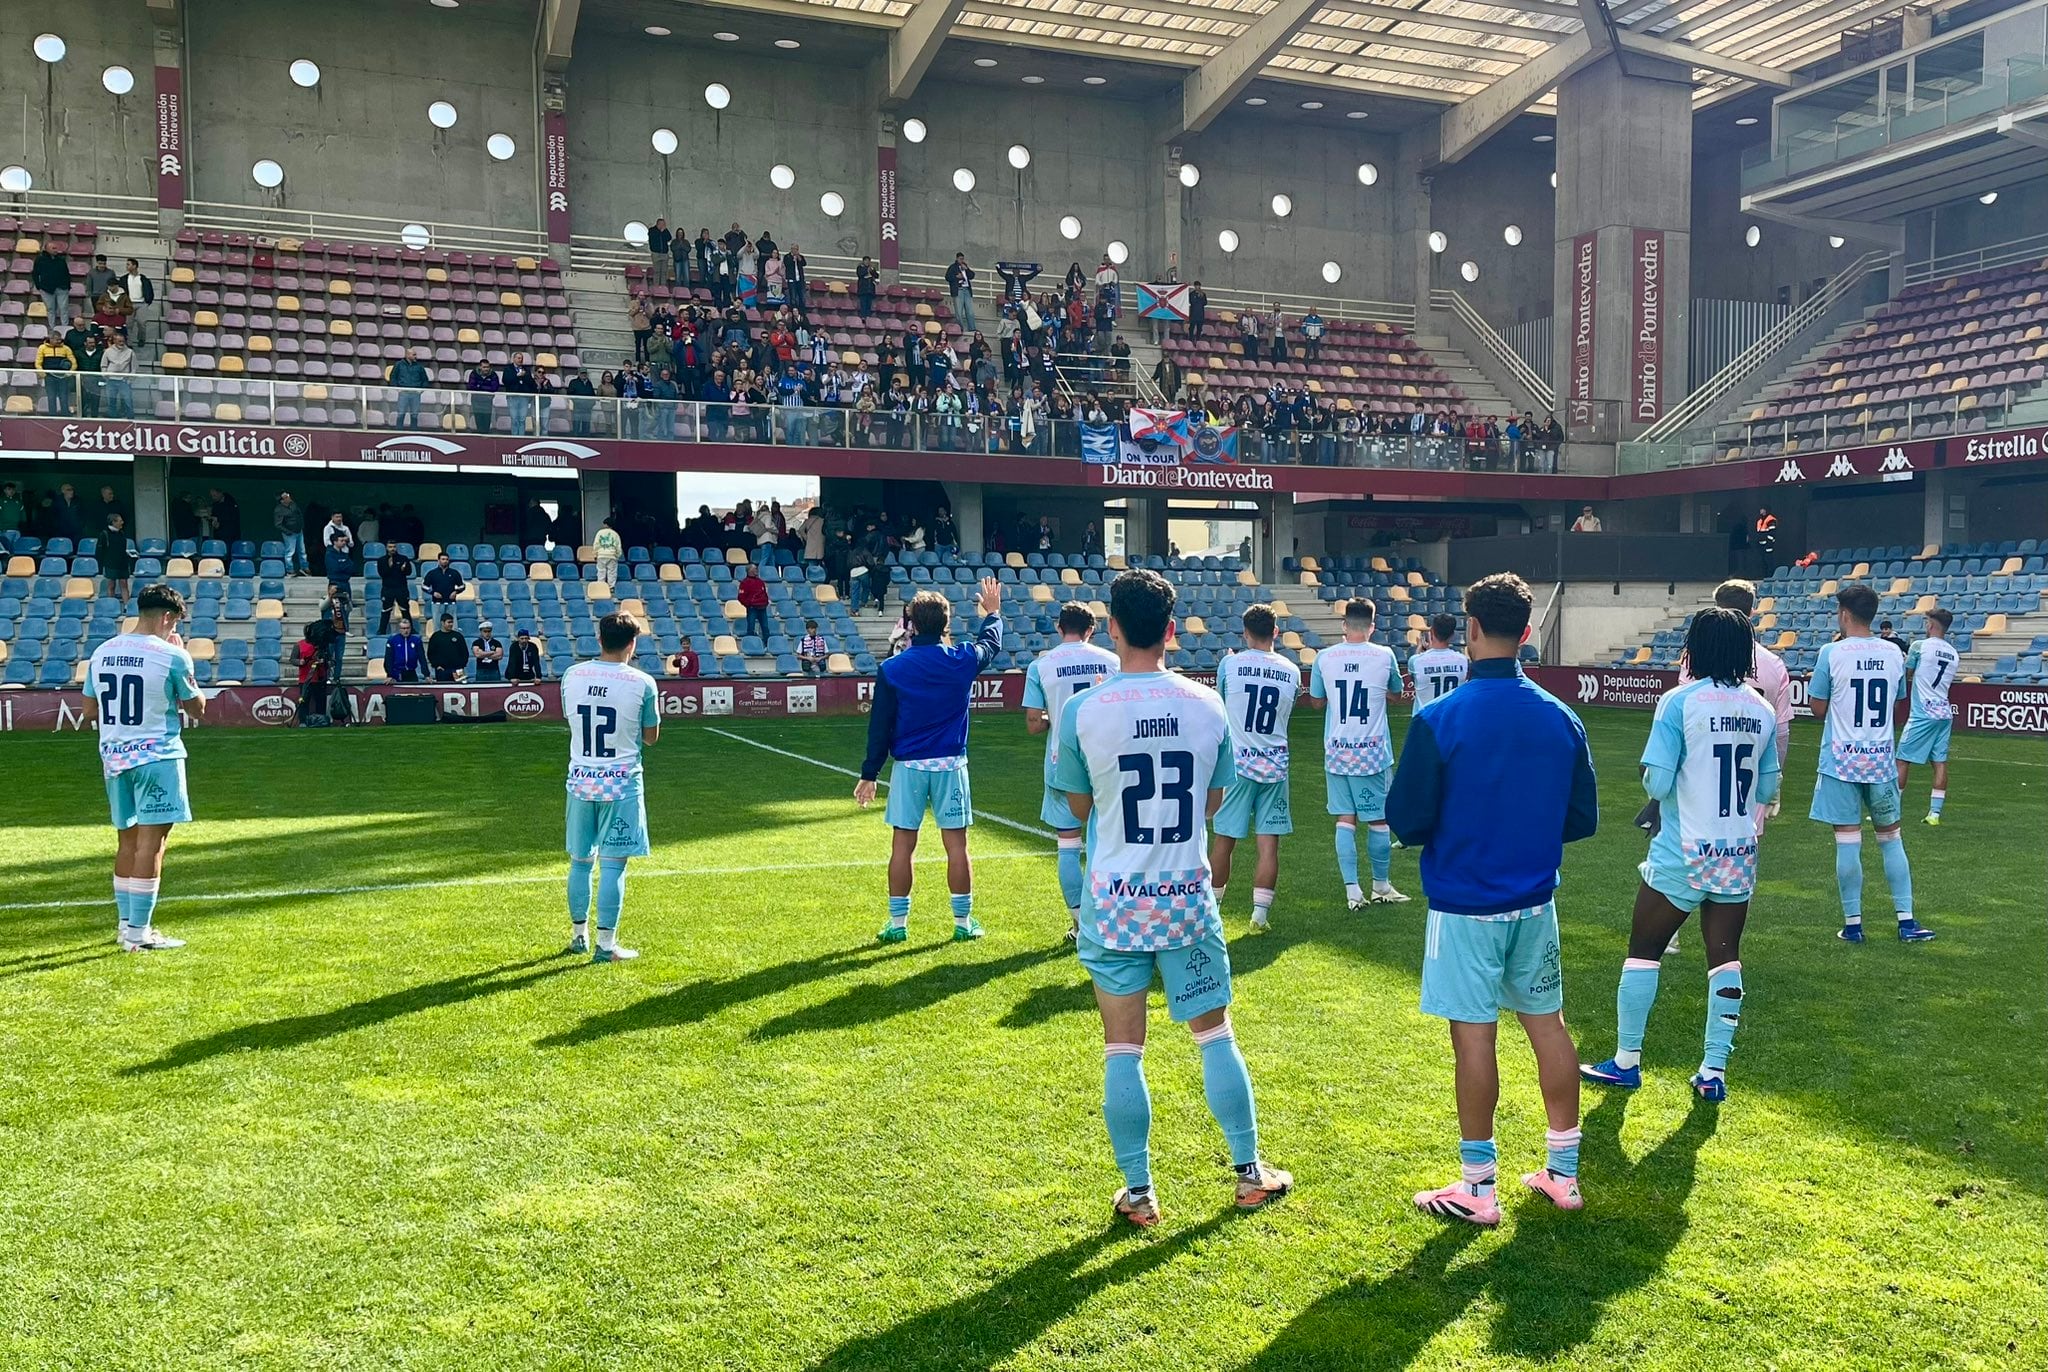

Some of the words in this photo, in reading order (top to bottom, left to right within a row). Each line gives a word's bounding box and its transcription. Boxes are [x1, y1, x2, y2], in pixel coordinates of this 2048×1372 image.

[158, 93, 170, 150] Deputación
[169, 94, 178, 151] Pontevedra
[547, 135, 558, 187] Deputación
[557, 136, 565, 188] Pontevedra
[881, 169, 889, 218] Deputación
[60, 423, 171, 451] Estrella
[176, 427, 275, 455] Galicia
[1965, 434, 2038, 462] Estrella
[1126, 452, 1141, 463] ON
[1145, 452, 1175, 464] TOUR
[102, 656, 115, 667] PAU
[116, 656, 144, 668] FERRER
[1344, 663, 1359, 673] XEMI
[1864, 658, 1885, 671] LÓPEZ
[1238, 666, 1261, 677] BORJA
[1263, 666, 1291, 683] VÁZQUEZ
[1603, 674, 1662, 690] Deputación
[1931, 660, 1949, 690] 7
[99, 673, 143, 726] 20
[587, 685, 608, 697] KOKE
[659, 690, 698, 714] ías
[710, 689, 725, 697] HCI
[1335, 679, 1370, 725] 14
[1850, 678, 1888, 728] 19
[258, 708, 293, 718] MAFARI
[509, 703, 541, 712] MAFARI
[1244, 684, 1280, 735] 18
[577, 704, 617, 757] 12
[1133, 713, 1179, 739] JORRÍN
[1710, 717, 1719, 732] E.
[1720, 717, 1762, 734] FRIMPONG
[109, 743, 152, 754] ALCARCE
[581, 770, 627, 778] VALCARCE
[1713, 743, 1754, 818] 16
[1118, 750, 1194, 845] 23
[1715, 845, 1756, 857] VALCAR
[1127, 881, 1201, 897] VALCARCE
[1175, 981, 1221, 1003] PONFERRADA
